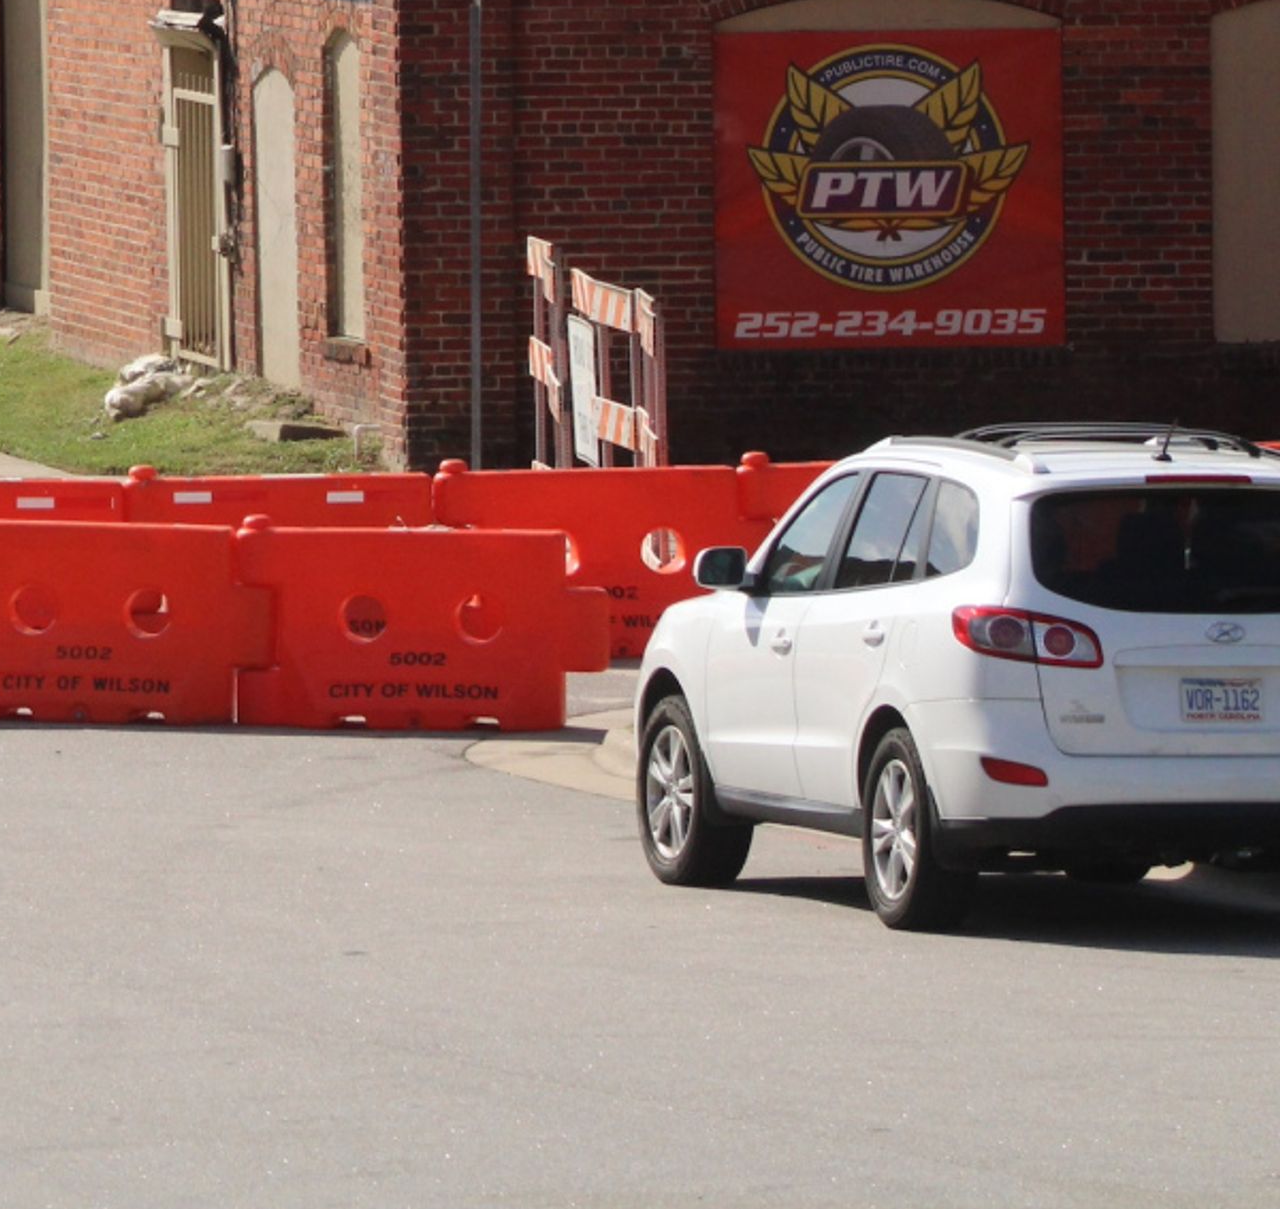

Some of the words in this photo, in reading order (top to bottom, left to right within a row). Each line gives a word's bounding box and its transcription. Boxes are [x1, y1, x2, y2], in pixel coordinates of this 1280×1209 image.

[824, 54, 941, 81] PUBLICTIRE.COM
[810, 169, 954, 209] PTW
[796, 231, 848, 274] PUBLIC
[849, 264, 884, 283] TIRE
[889, 229, 975, 283] WAREHOUSE
[734, 307, 1048, 339] 252-234-9035
[56, 645, 113, 660] 5002
[390, 652, 447, 666] 5002
[1, 674, 46, 690] CITY
[57, 676, 83, 691] OF
[93, 677, 170, 694] WILSON
[328, 683, 375, 699] CITY
[380, 683, 410, 699] OF
[415, 684, 499, 700] WILSON
